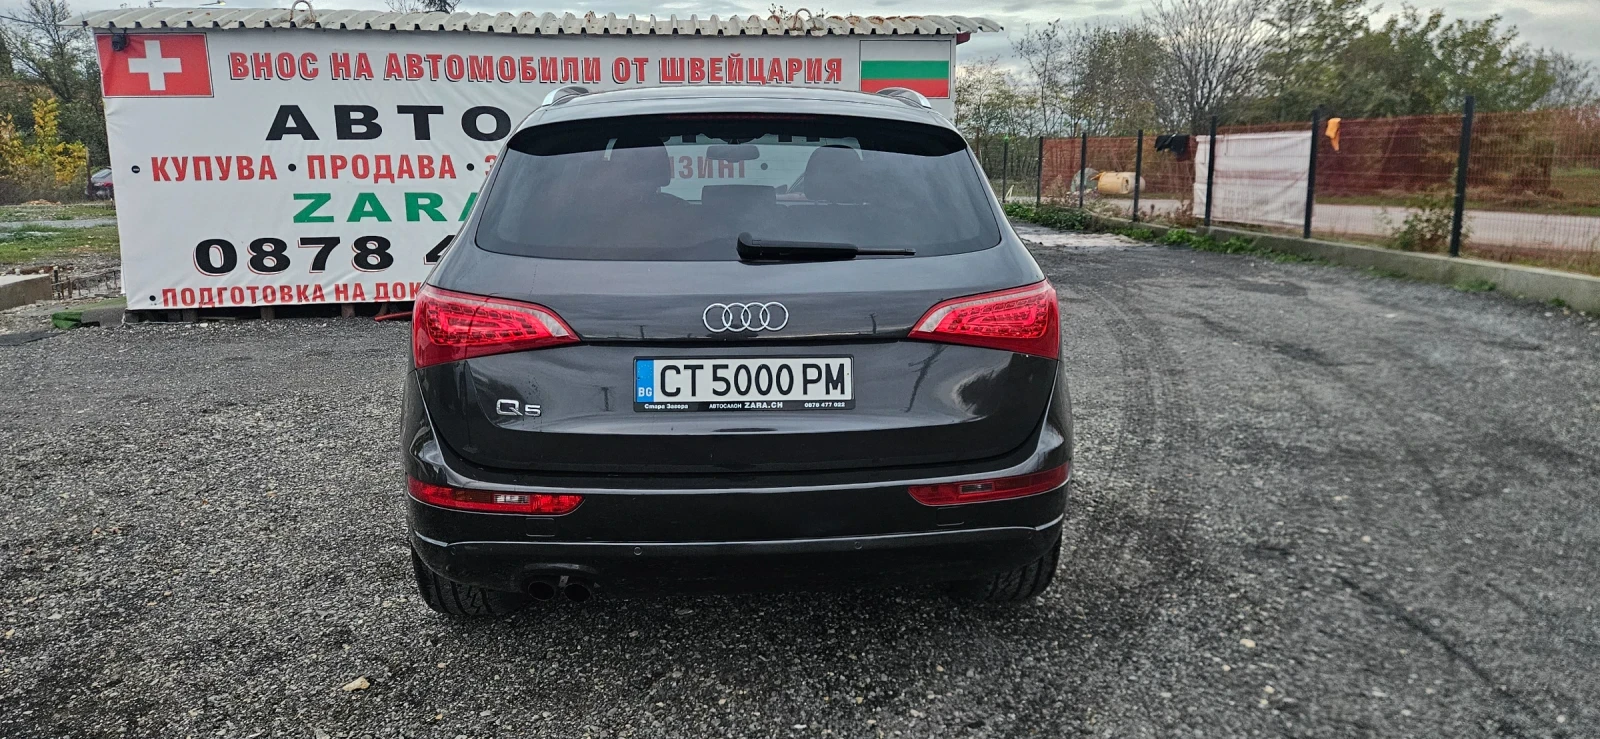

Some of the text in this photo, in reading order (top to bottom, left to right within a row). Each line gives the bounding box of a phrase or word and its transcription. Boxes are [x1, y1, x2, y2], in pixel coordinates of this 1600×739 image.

[228, 52, 843, 86] ВНОС НА АВТОМОБИЛИ ОТ ШВЕЙЦАРИЯ
[150, 155, 278, 183] КУПУВА
[306, 153, 457, 183] ПРОДАВА
[193, 235, 394, 276] 0878
[161, 283, 326, 308] ПОДГОТОВКА
[334, 282, 367, 302] НА
[638, 387, 652, 397] BG
[661, 363, 845, 396] CT 5000 PM
[496, 399, 541, 416] Q5
